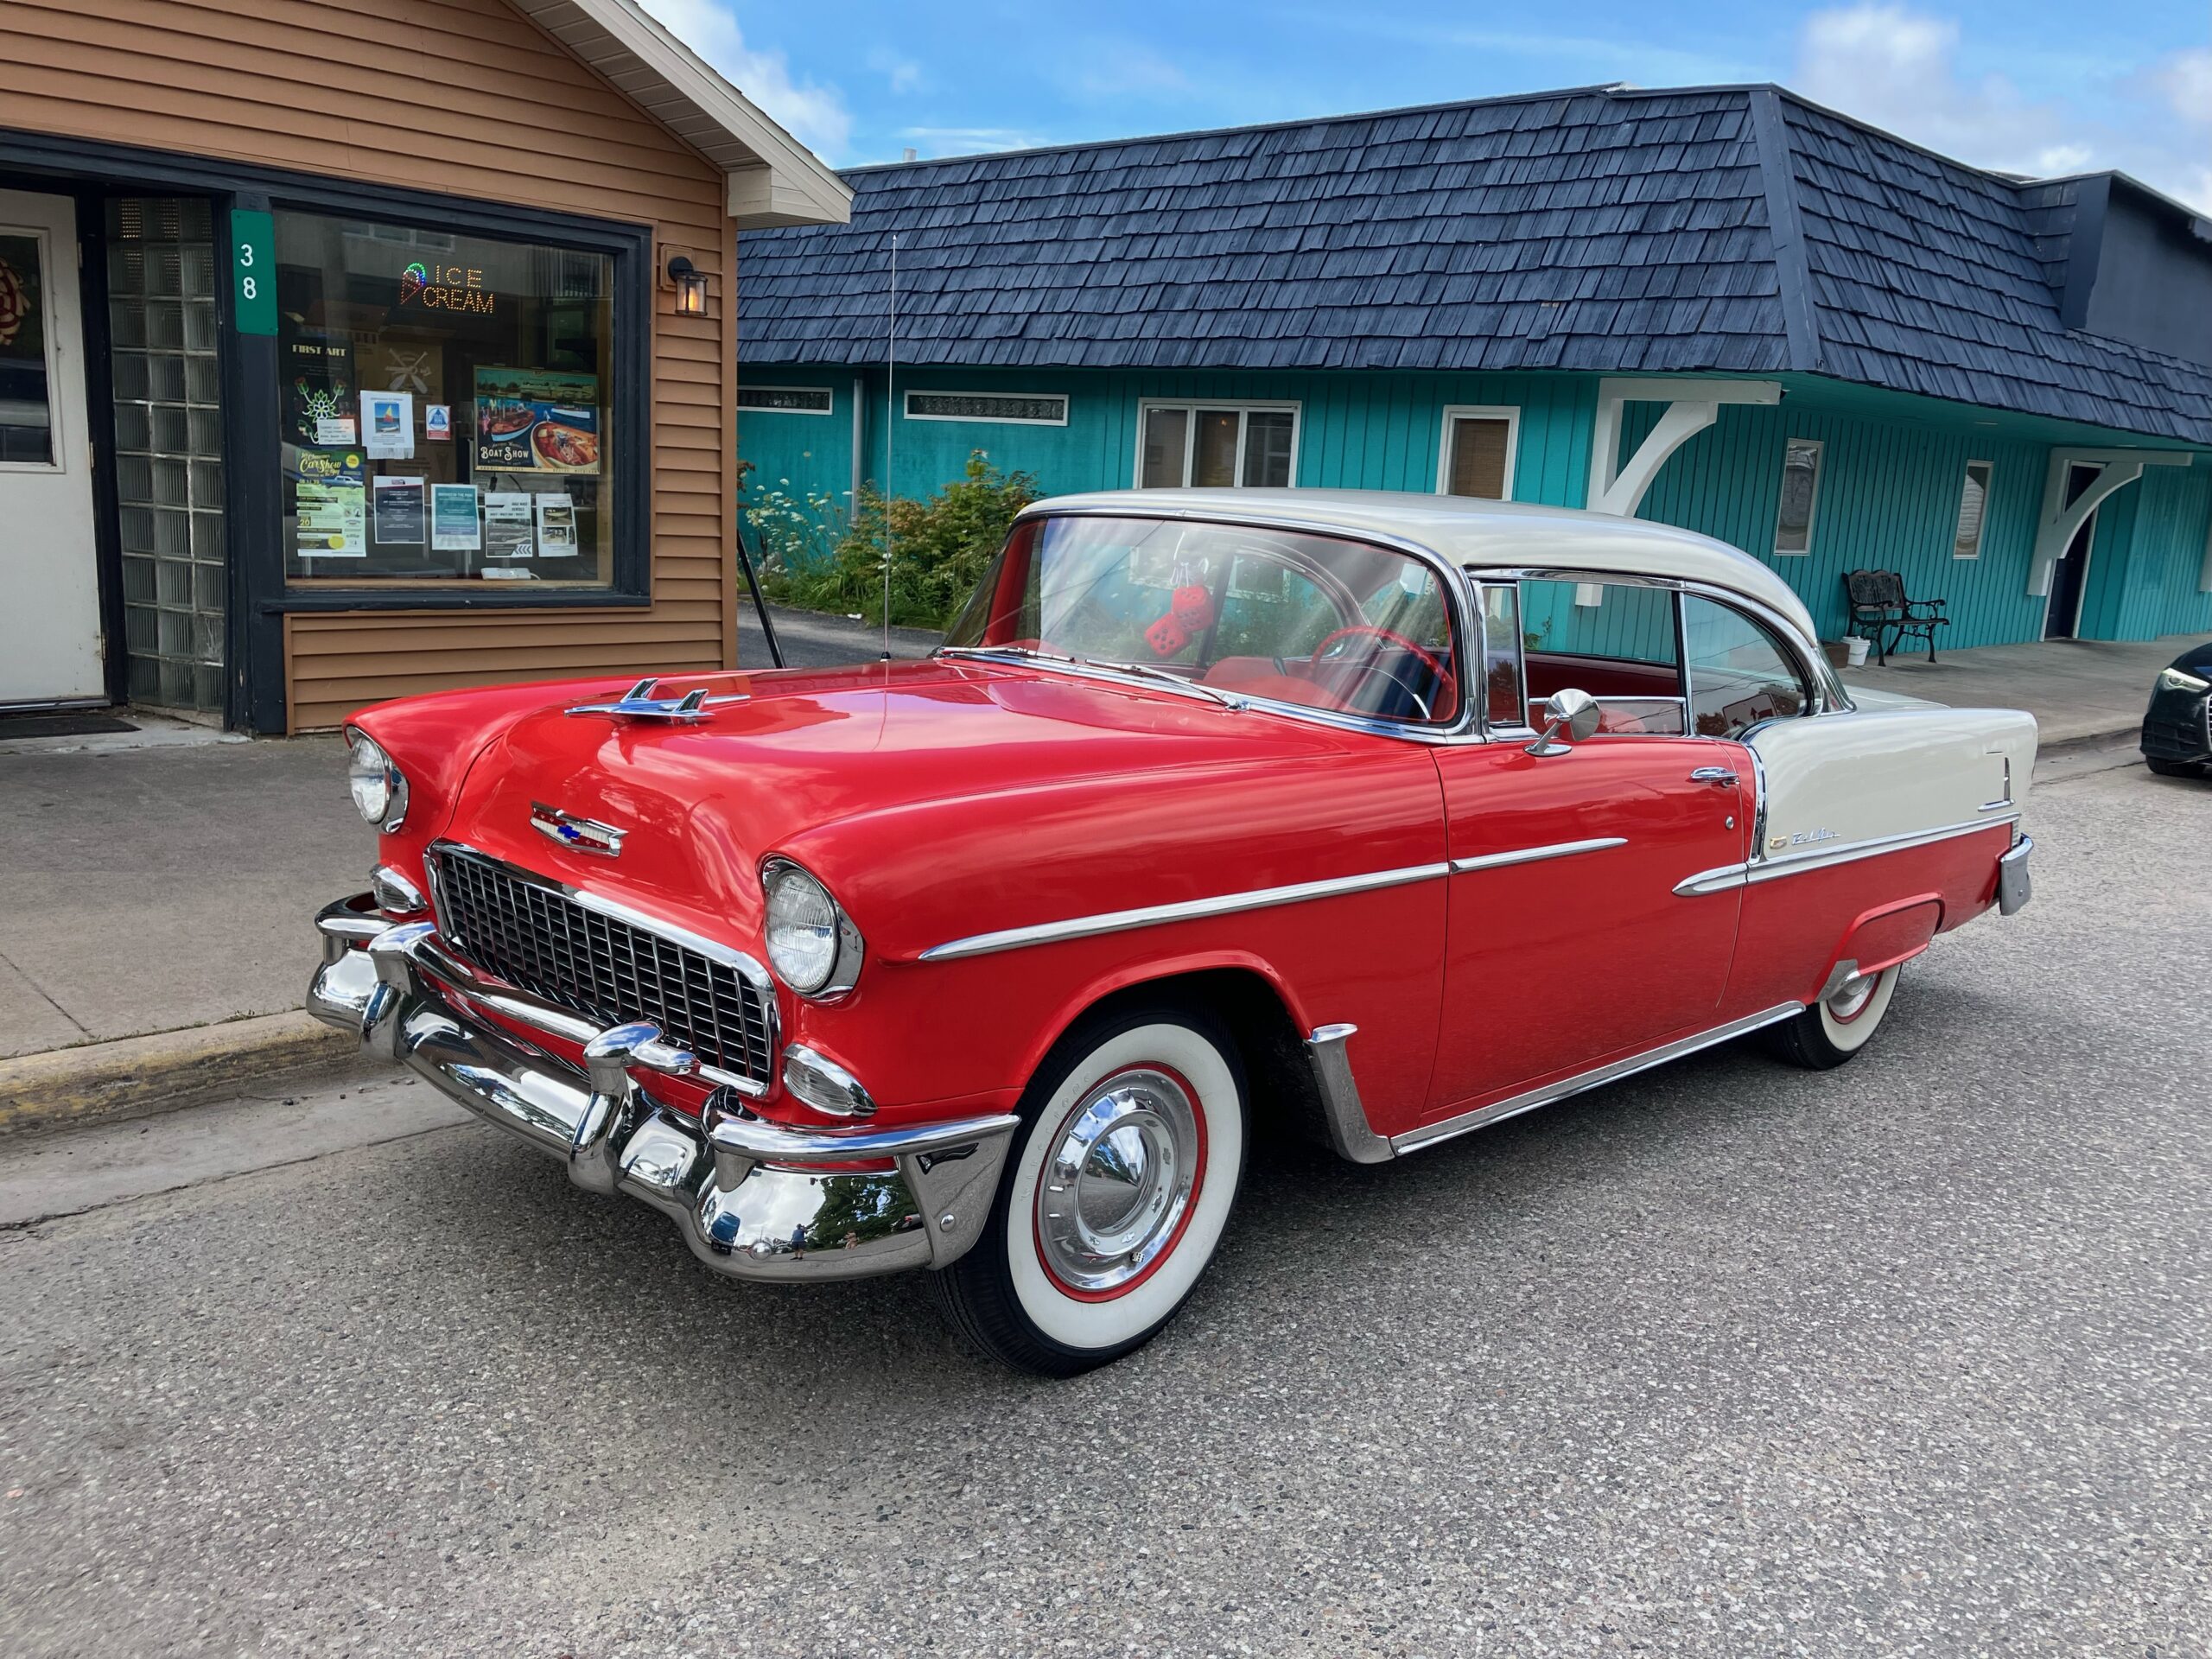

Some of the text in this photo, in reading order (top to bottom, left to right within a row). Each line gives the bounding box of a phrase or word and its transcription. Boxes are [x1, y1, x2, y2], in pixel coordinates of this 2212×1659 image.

[240, 244, 257, 300] 38
[435, 264, 483, 289] ICE
[422, 286, 494, 314] CREAM
[292, 344, 346, 357] FIRST ART
[480, 446, 530, 461] BOAT SHOW
